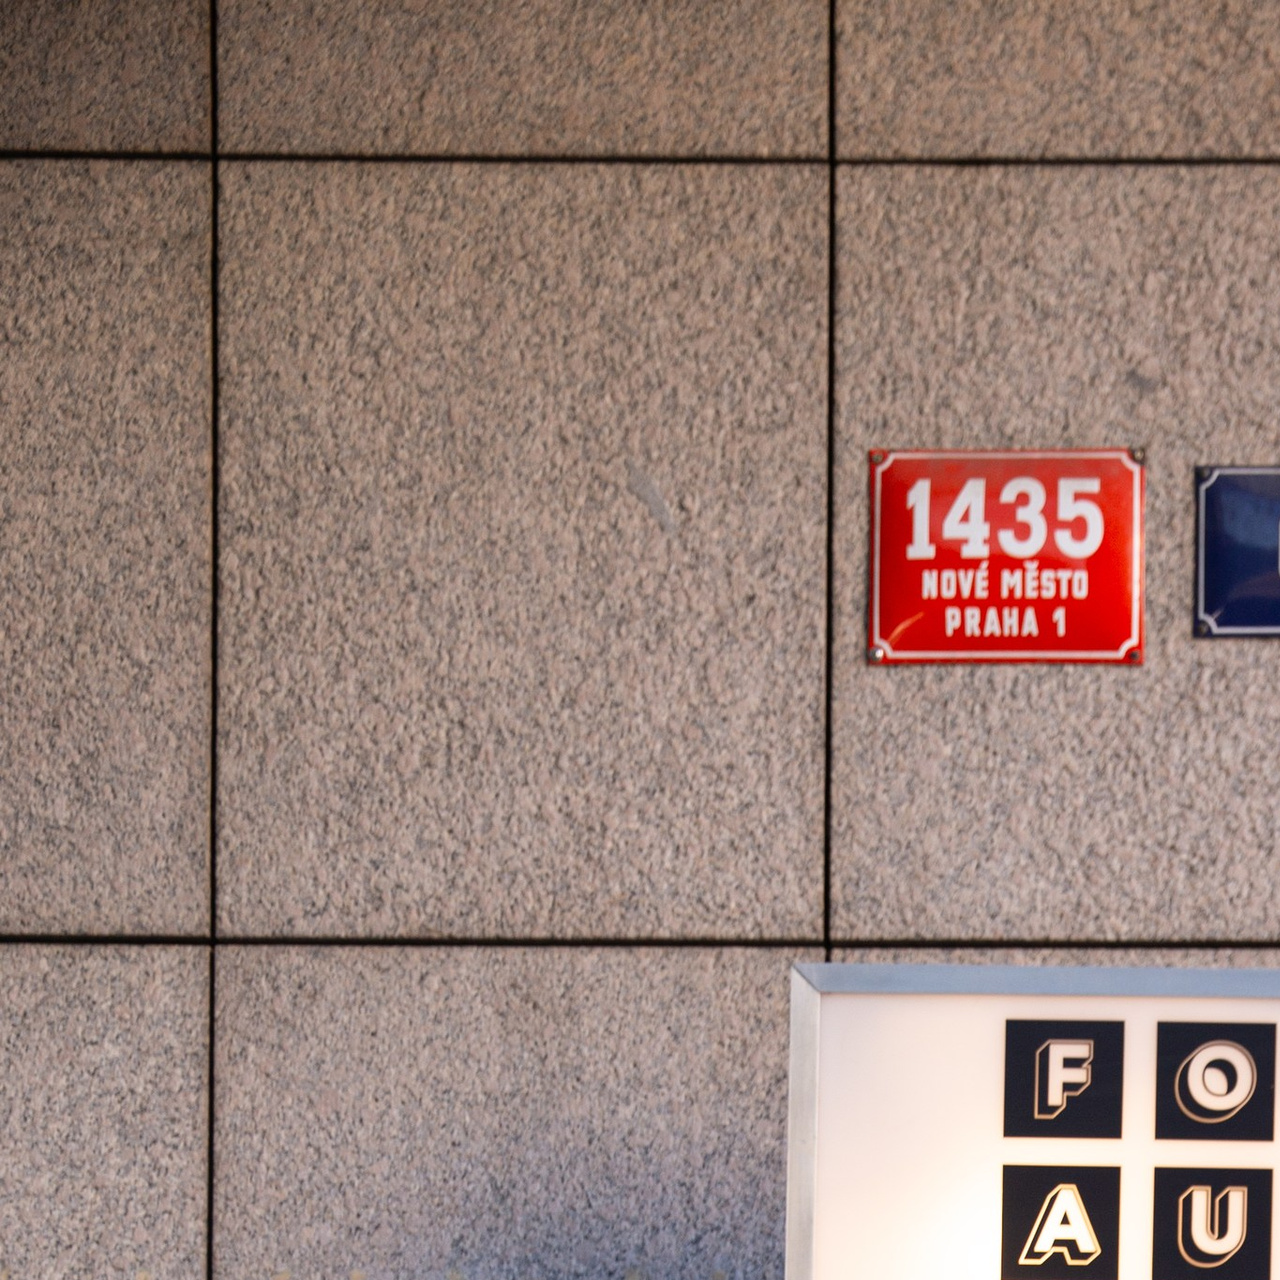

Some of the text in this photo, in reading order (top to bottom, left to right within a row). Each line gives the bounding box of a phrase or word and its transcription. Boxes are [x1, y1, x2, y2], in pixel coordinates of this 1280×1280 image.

[905, 477, 1105, 561] 1435
[922, 559, 1088, 600] NOVÉ MĚSTO
[945, 607, 1067, 637] PRAHA 1
